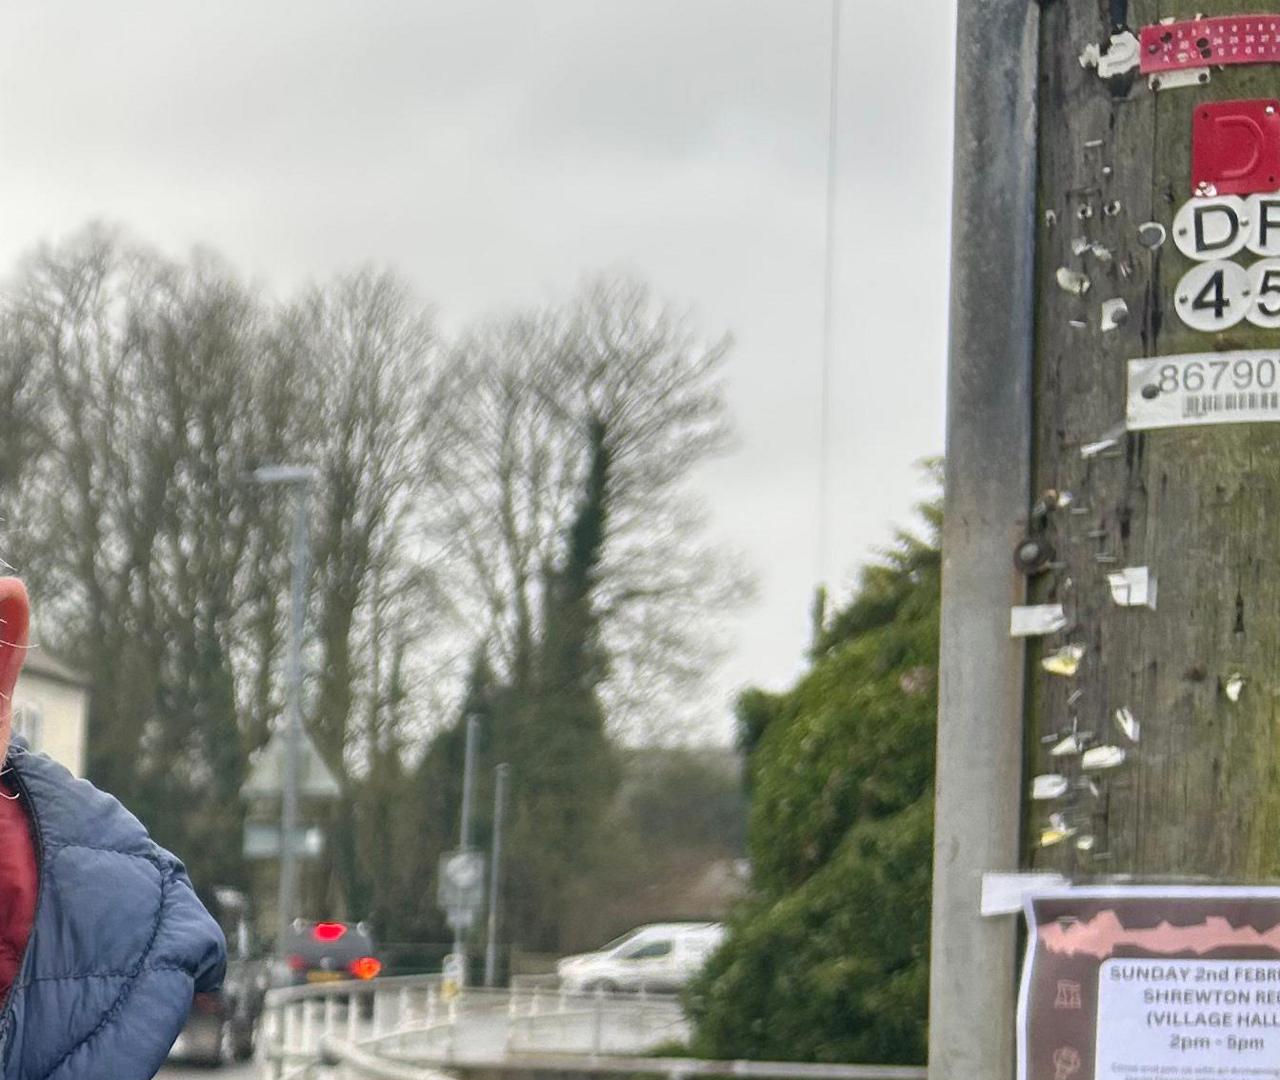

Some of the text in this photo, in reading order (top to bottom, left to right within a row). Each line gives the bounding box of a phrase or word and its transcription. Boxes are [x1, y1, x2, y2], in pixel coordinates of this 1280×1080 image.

[1158, 357, 1280, 394] 86790
[1110, 965, 1280, 983] SUNDAY 2nd FEBR
[1143, 988, 1250, 1005] SHREWTON
[1146, 1010, 1233, 1028] (VILLAGE
[1170, 1034, 1211, 1053] 2pm
